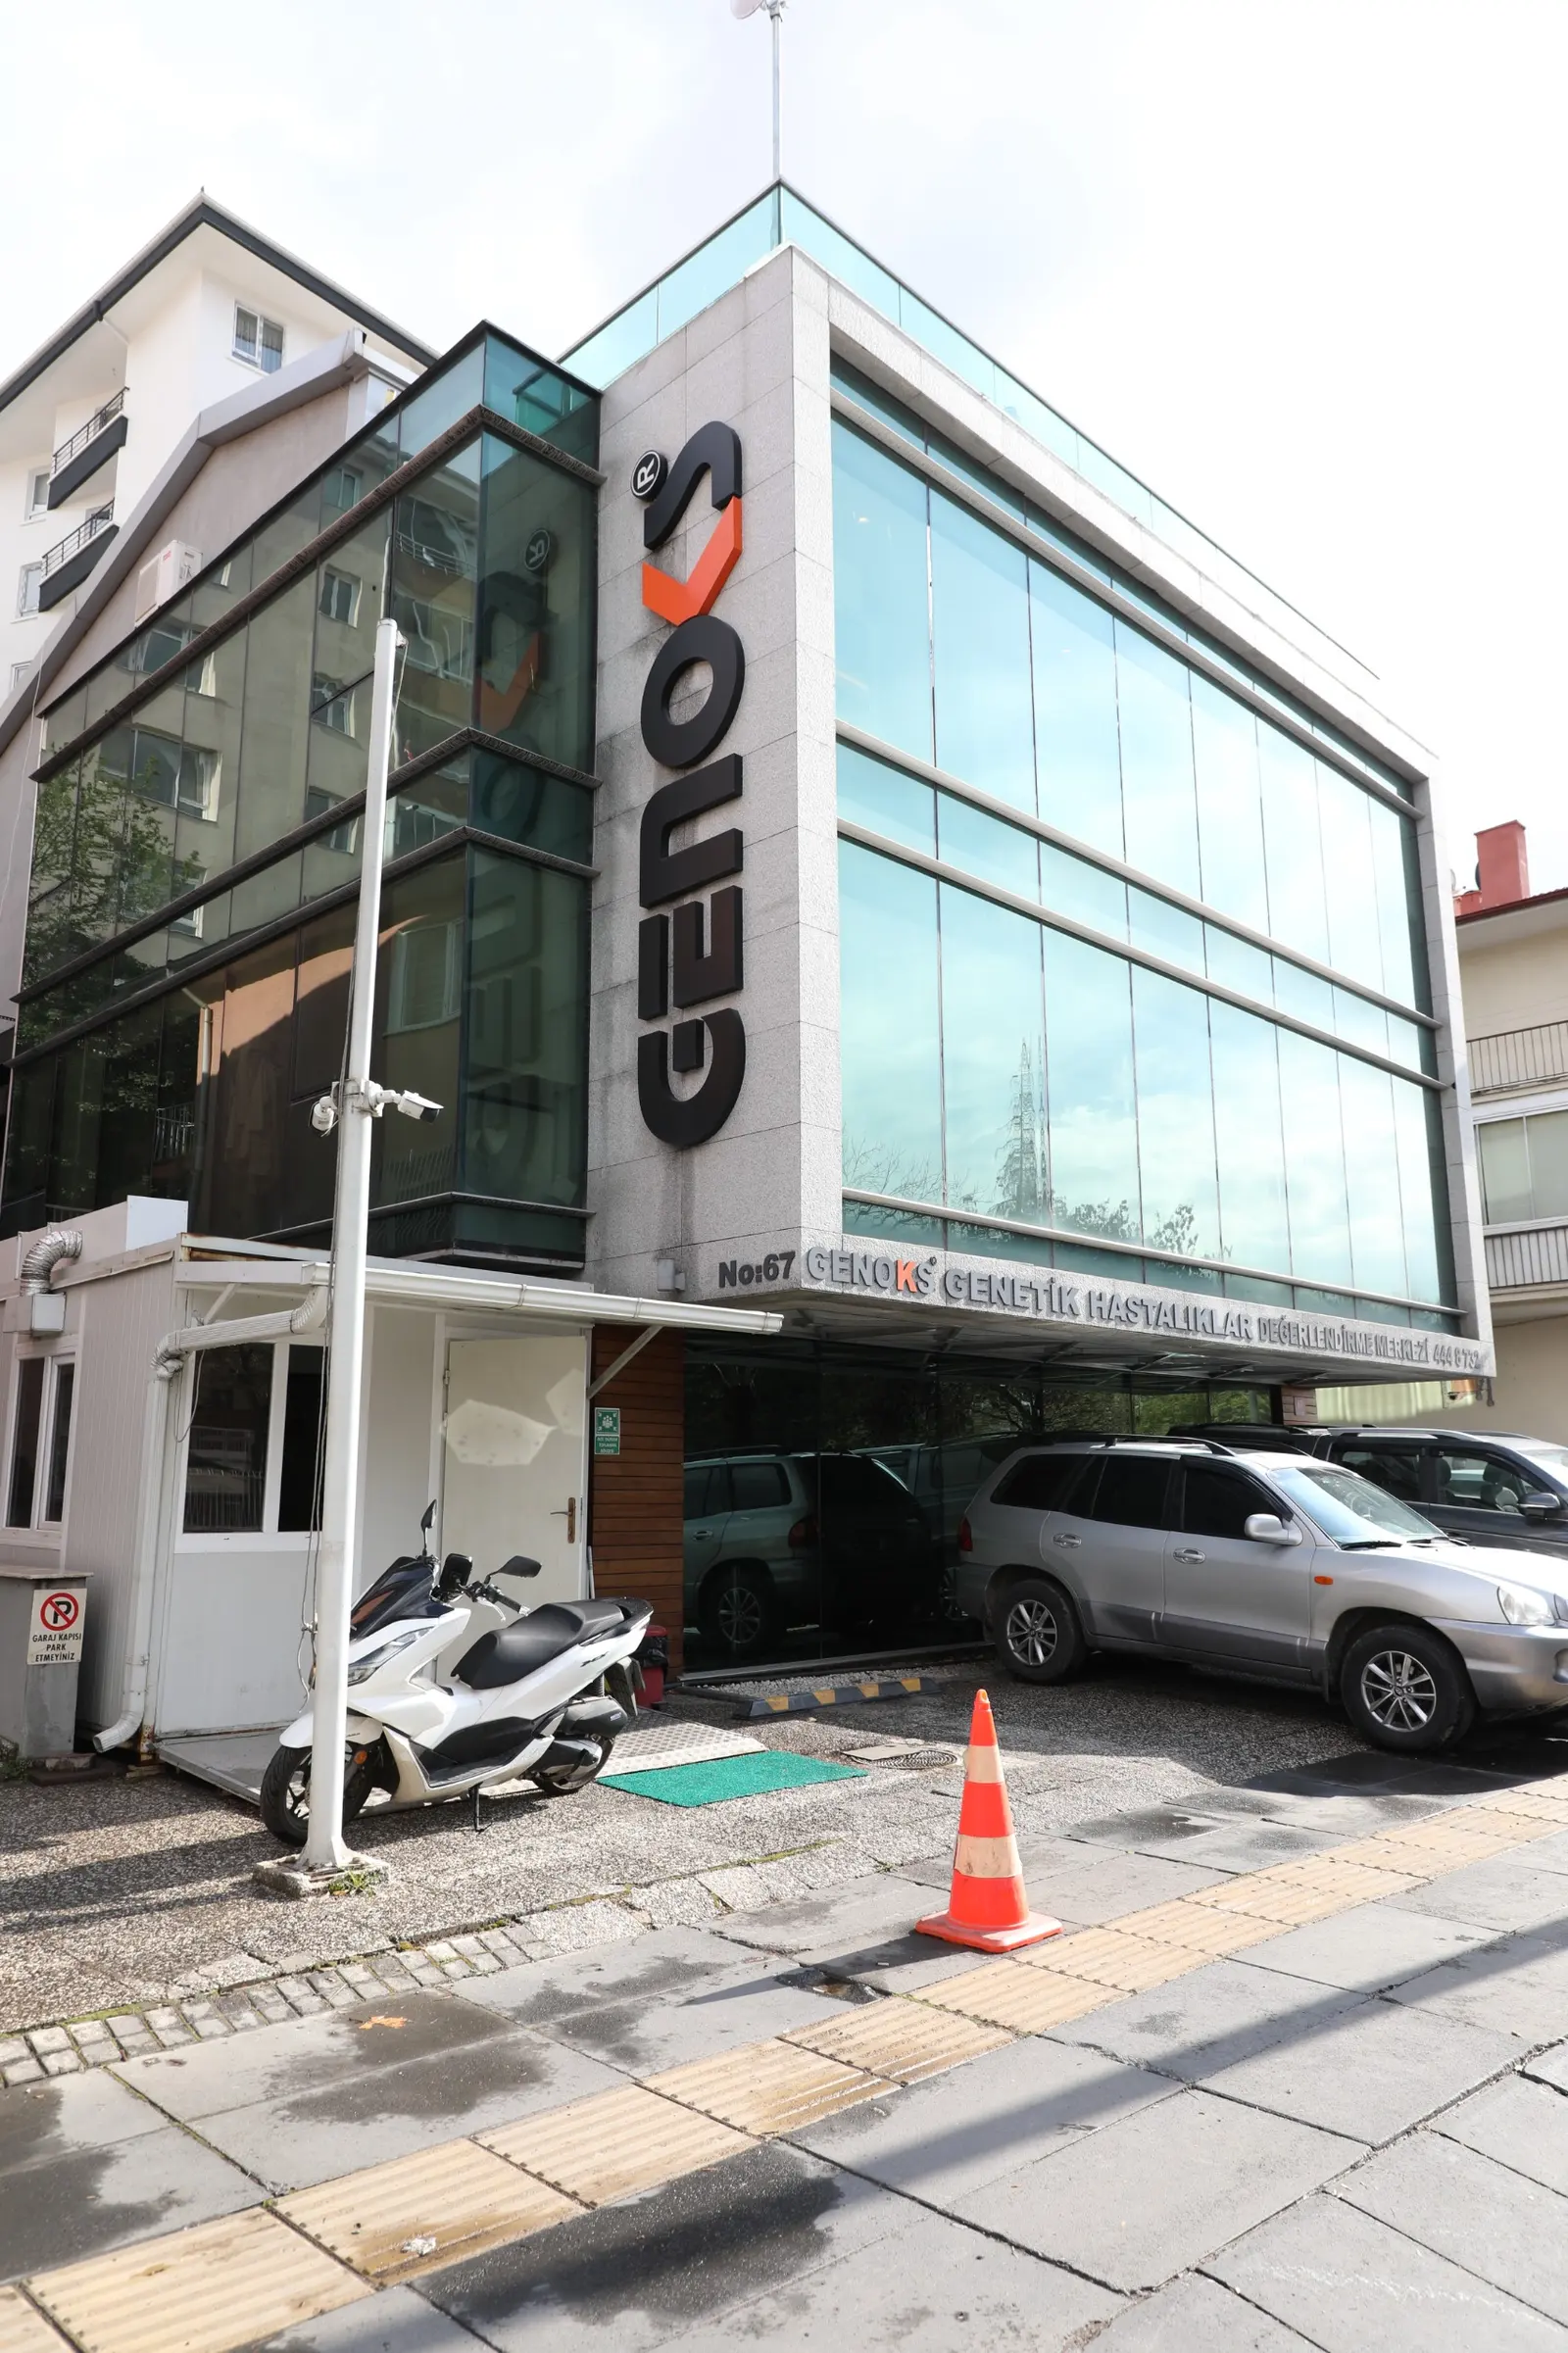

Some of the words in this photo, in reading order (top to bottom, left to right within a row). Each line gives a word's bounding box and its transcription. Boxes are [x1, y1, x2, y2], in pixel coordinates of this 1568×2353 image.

[718, 1250, 796, 1288] No:67
[808, 1246, 935, 1295] GENOKS
[945, 1268, 1080, 1316] GENETİK
[1089, 1291, 1253, 1340] HASTALIKLAR
[1258, 1315, 1373, 1355] DEĞERLENDİRME
[1374, 1334, 1429, 1363] MERKEZİ
[1433, 1344, 1452, 1367] 444
[35, 1652, 75, 1662] ETMEYİNİZ
